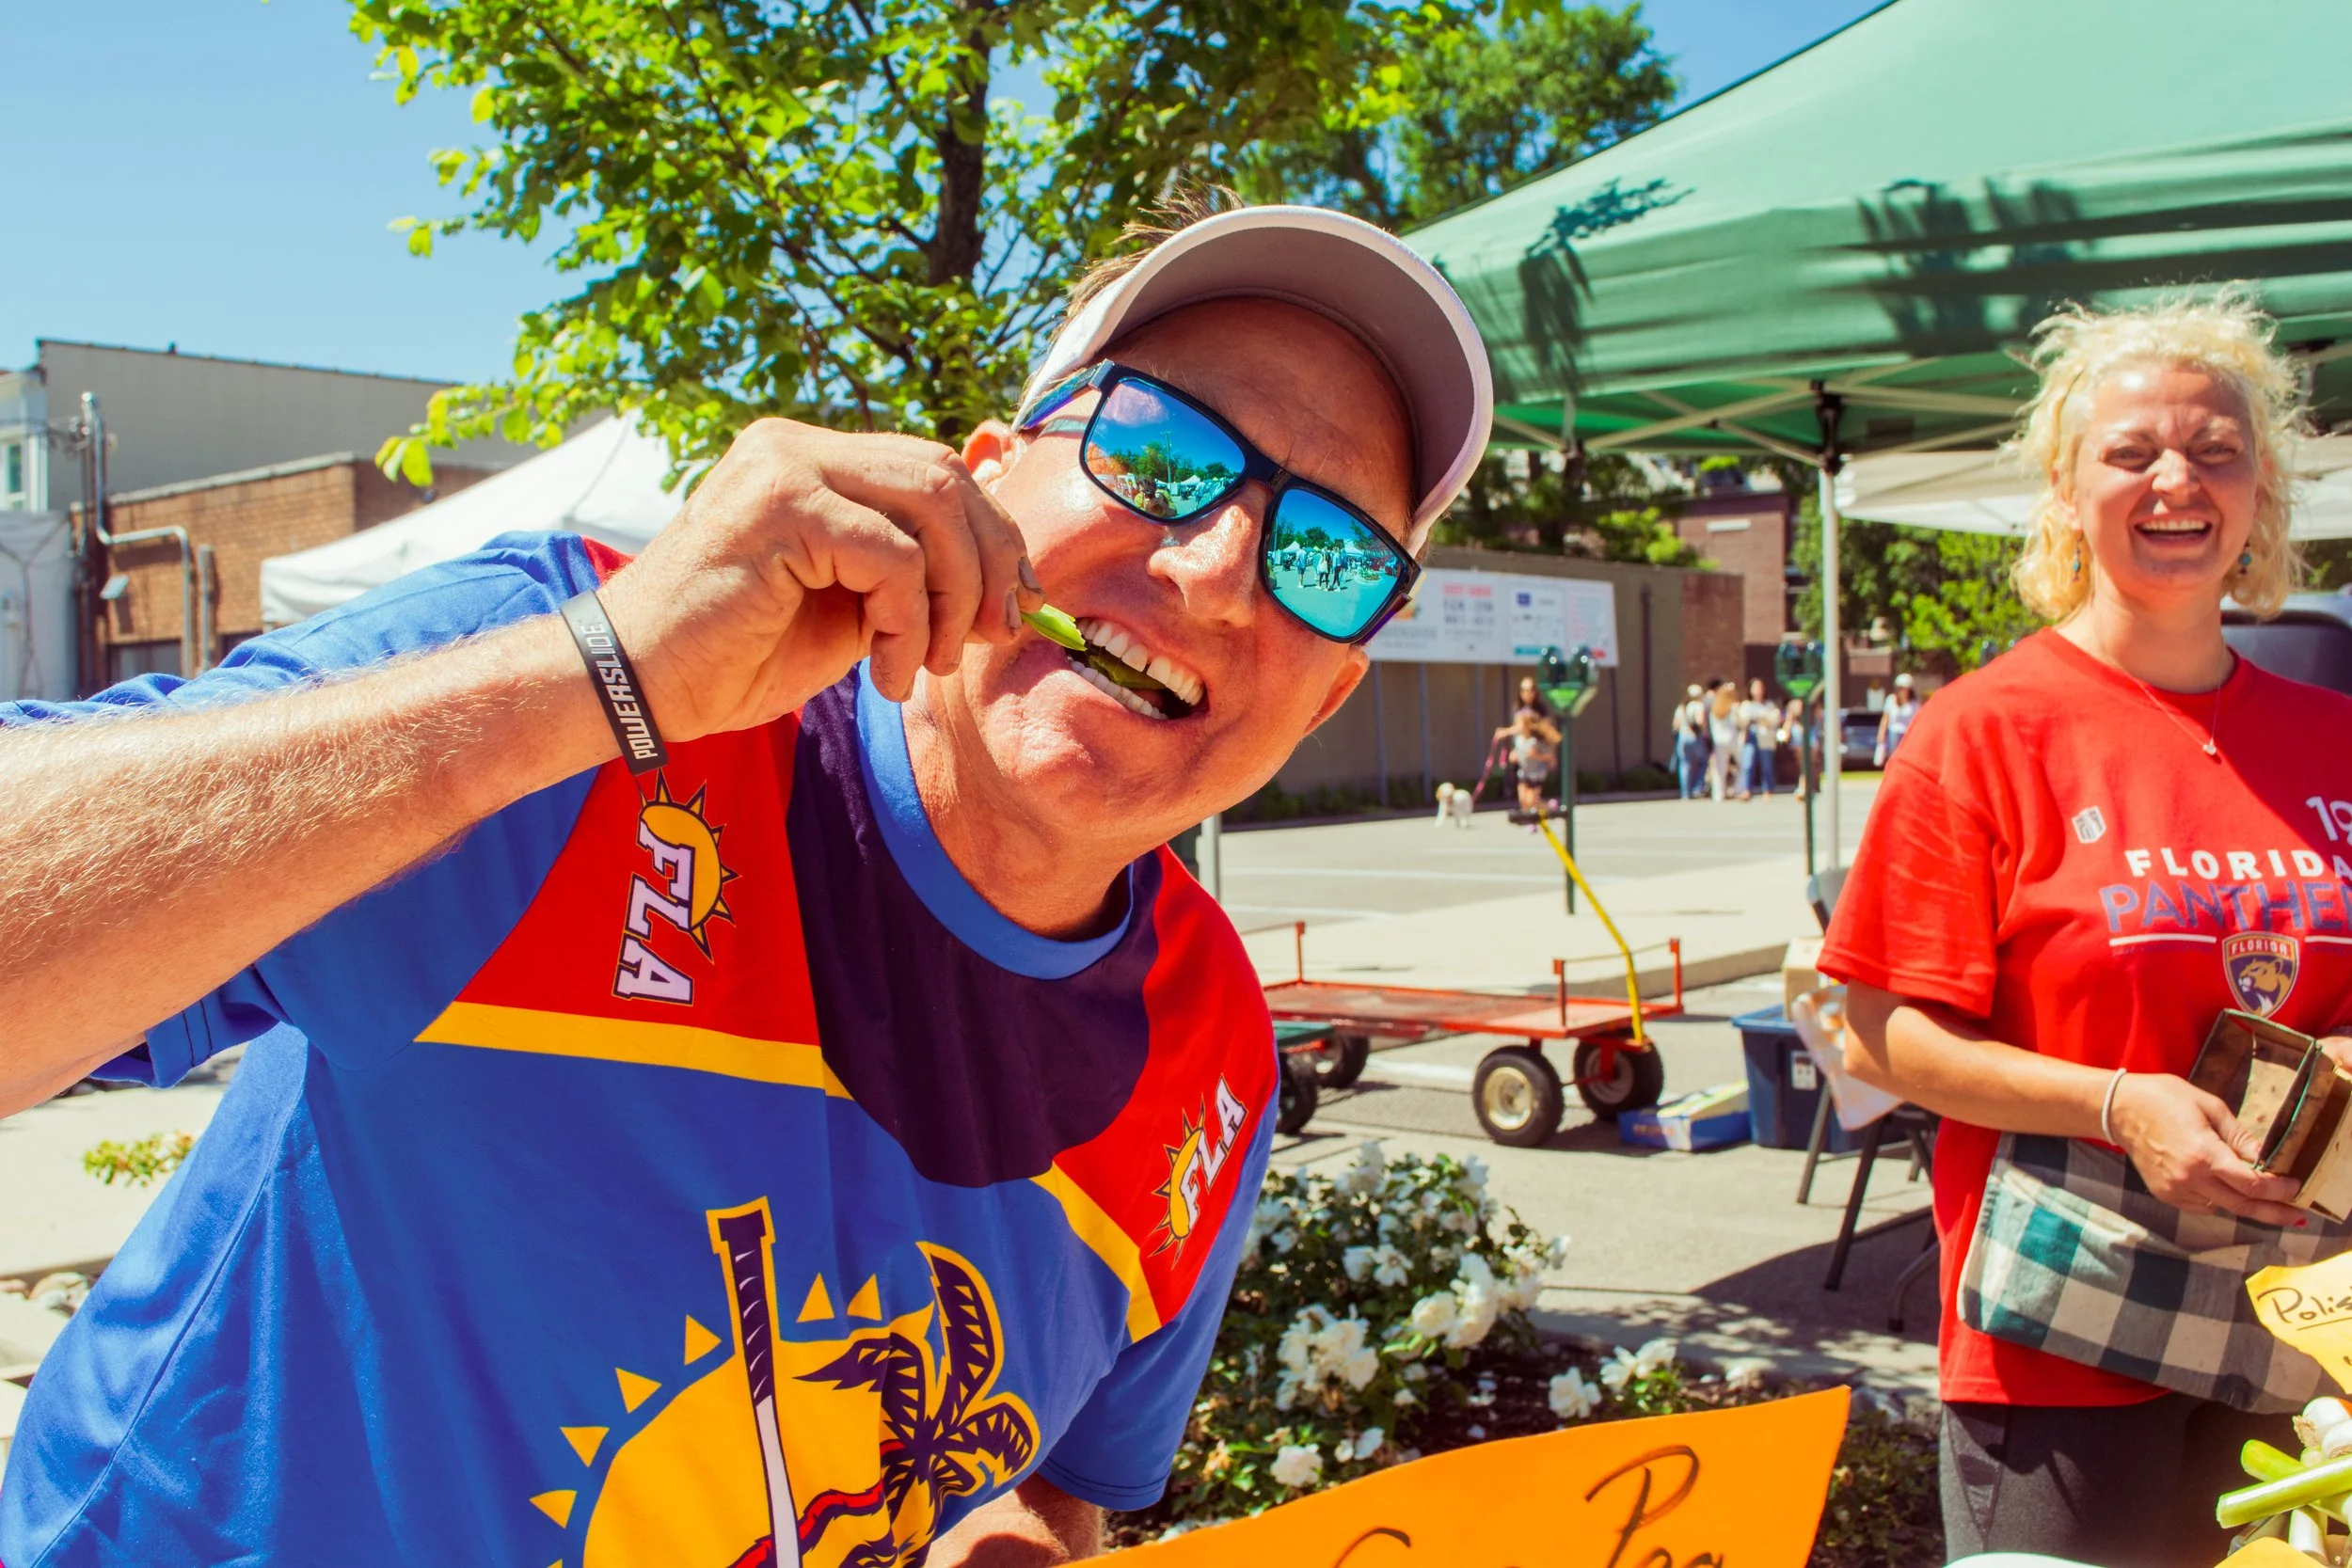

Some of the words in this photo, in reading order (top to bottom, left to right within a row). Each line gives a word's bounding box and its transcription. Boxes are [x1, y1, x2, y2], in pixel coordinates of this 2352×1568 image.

[580, 621, 659, 760] POWERSLIDE
[612, 819, 694, 1006] FLA
[2231, 939, 2288, 957] FLORIDA
[1179, 1072, 1249, 1232] FLA
